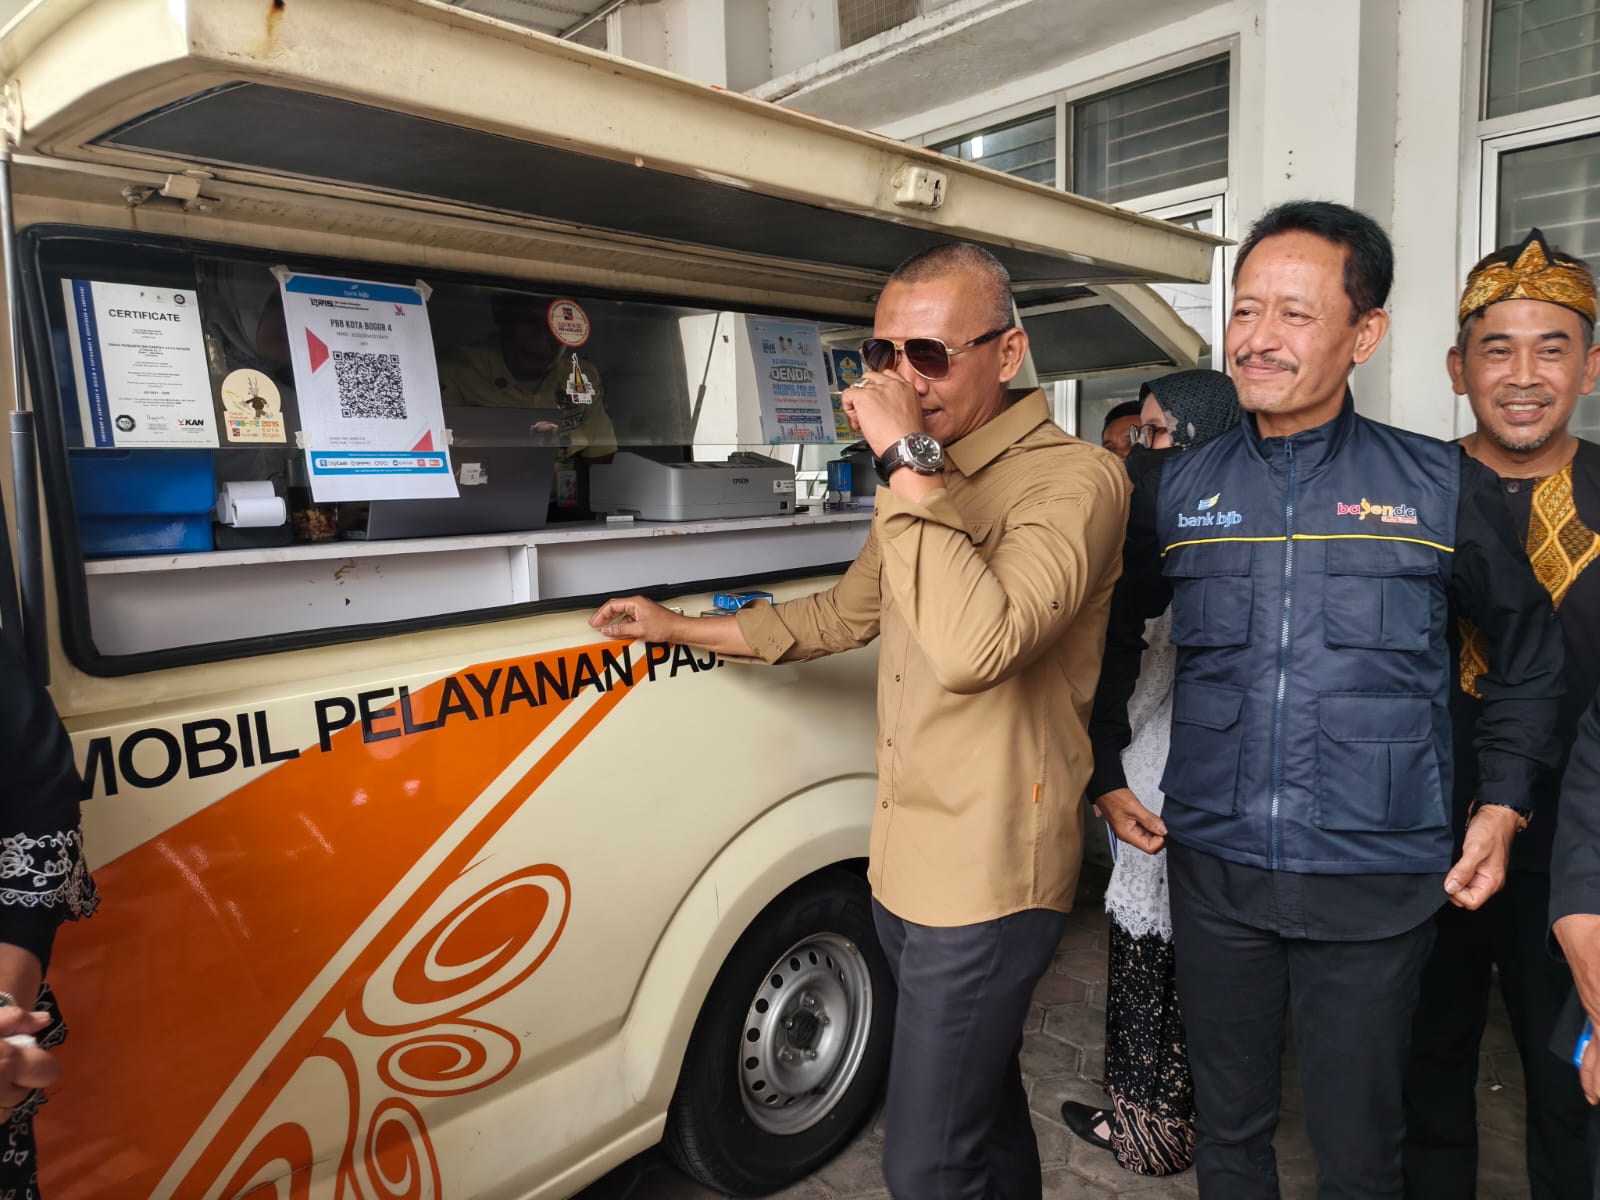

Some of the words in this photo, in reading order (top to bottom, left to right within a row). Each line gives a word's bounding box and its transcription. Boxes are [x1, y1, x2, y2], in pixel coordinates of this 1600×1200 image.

[310, 298, 334, 308] QRIS
[108, 309, 181, 322] CERTIFICATE
[330, 318, 344, 328] PBB
[345, 320, 363, 330] KOTA
[364, 321, 386, 331] BOGOR
[387, 323, 392, 331] 4
[771, 367, 810, 382] DENDA
[1178, 512, 1214, 528] bank
[1216, 511, 1242, 528] bjb
[314, 643, 634, 753] PELAYANAN
[645, 641, 725, 682] PAJ
